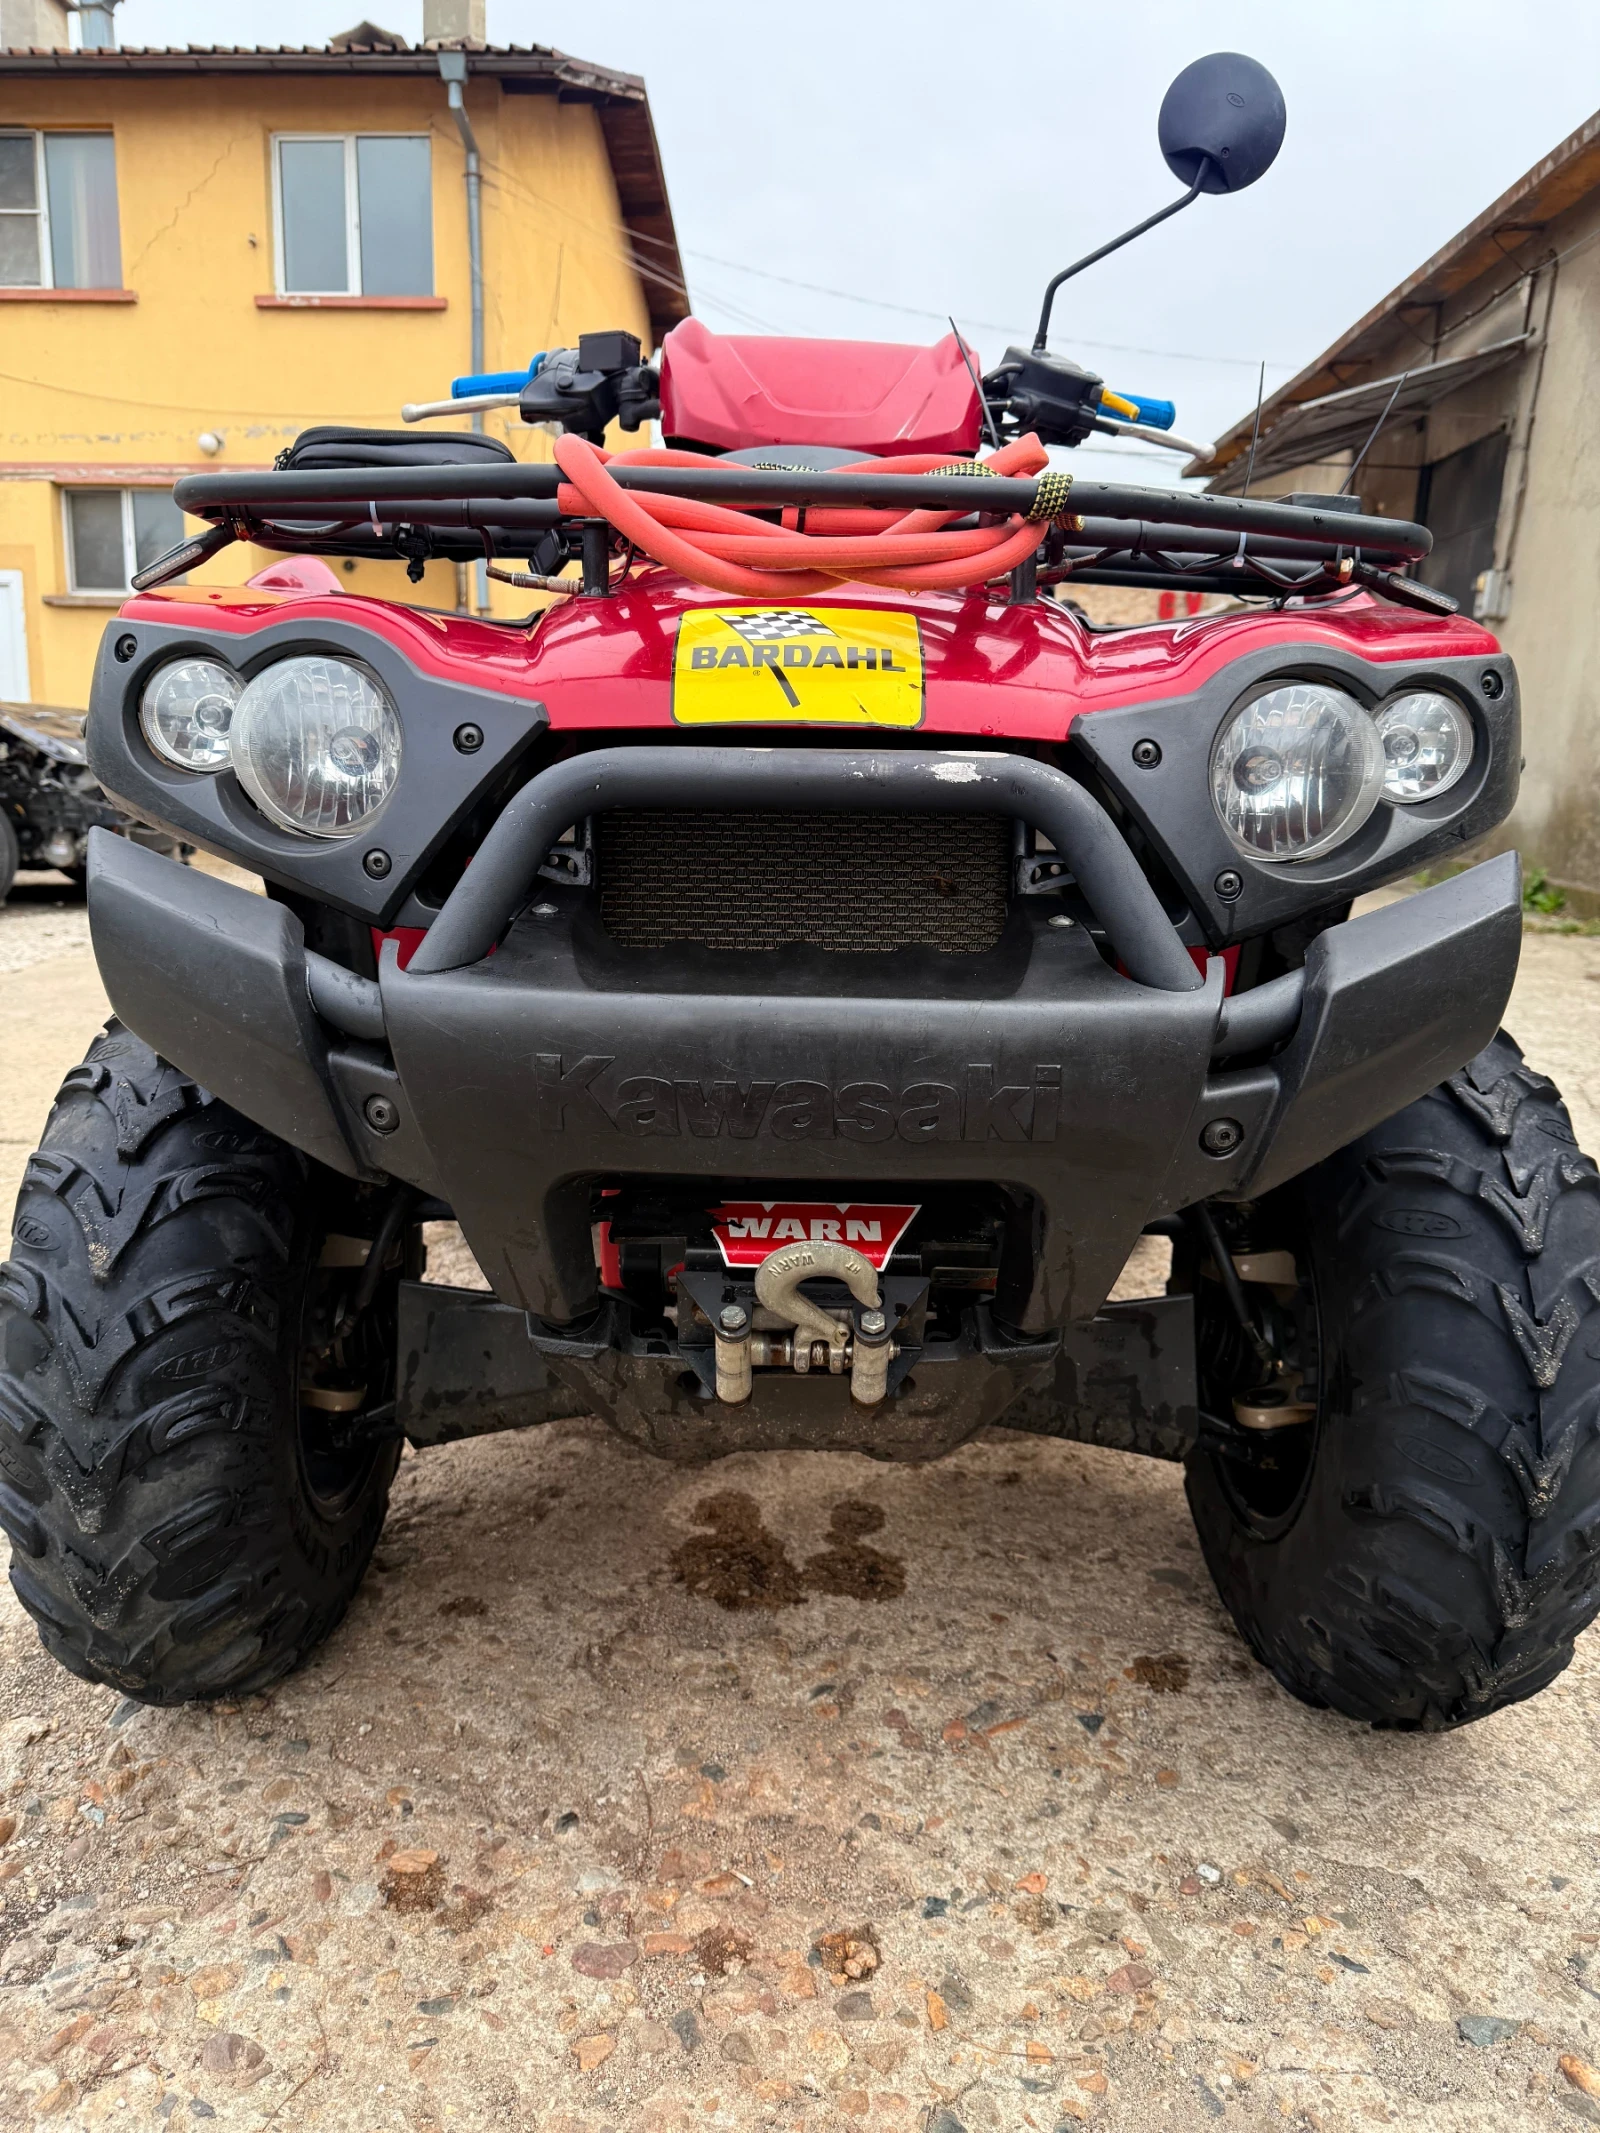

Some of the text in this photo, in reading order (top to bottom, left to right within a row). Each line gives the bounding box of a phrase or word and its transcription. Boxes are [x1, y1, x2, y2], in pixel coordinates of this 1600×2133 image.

[691, 644, 906, 672] BARDAHL
[536, 1053, 1062, 1142] Kawasaki
[727, 1217, 882, 1242] WARN
[767, 1252, 815, 1279] WARN
